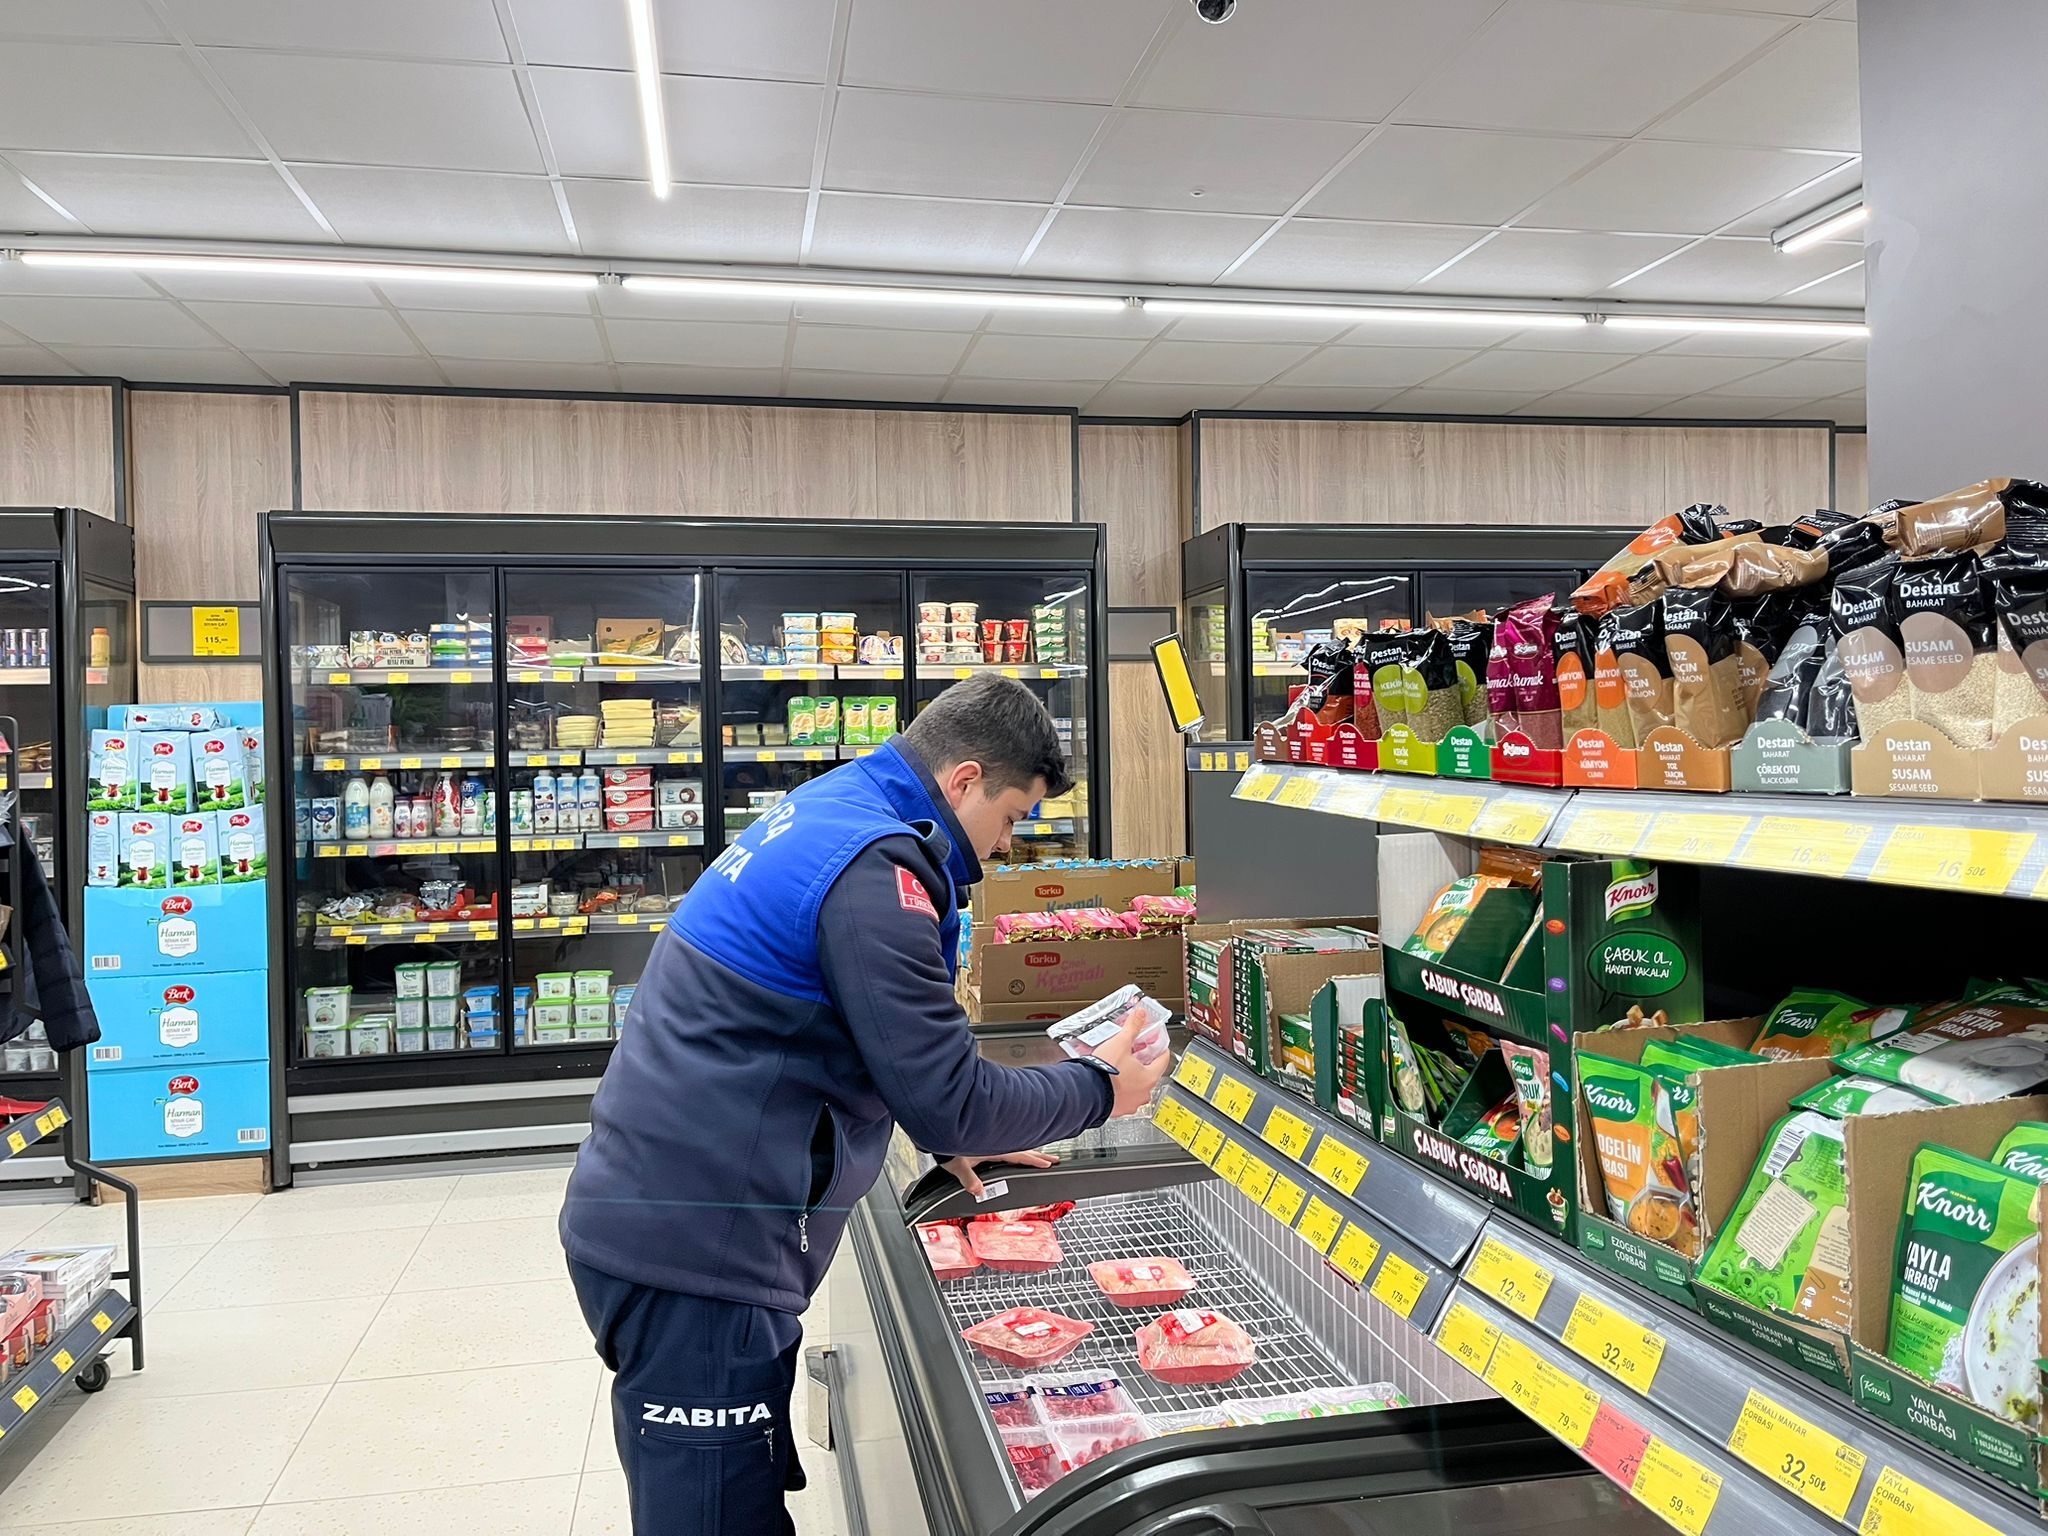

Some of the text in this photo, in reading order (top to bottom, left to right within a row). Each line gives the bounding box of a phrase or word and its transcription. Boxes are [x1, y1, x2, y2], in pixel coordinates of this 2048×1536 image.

[1900, 580, 1954, 597] Destan
[1841, 598, 1881, 616] Destan
[1906, 597, 1946, 608] BAHARAT
[1848, 611, 1877, 625] BAHARAT
[2006, 610, 2048, 626] Dest
[1555, 631, 1577, 643] Destan
[1906, 639, 1954, 653] SUSAM
[1370, 647, 1402, 661] Destan
[1844, 651, 1885, 665] SUSAM
[1513, 670, 1545, 688] Sumak
[1450, 736, 1473, 746] Destan
[1576, 738, 1605, 749] Destan
[1653, 741, 1684, 753] Destan
[1757, 737, 1795, 749] Destan
[1886, 737, 1932, 751] Destan
[2019, 736, 2048, 751] Des
[1762, 750, 1790, 758] BAHARAT
[1892, 753, 1926, 762] BAHARAT
[1892, 768, 1932, 781] SUSAM
[2026, 770, 2048, 783] SUS
[1037, 886, 1062, 897] Torku
[1607, 882, 1657, 908] Knorr
[1027, 953, 1058, 965] Torku
[1604, 946, 1673, 966] ÇABUK OL,
[1605, 964, 1633, 975] HAYATI
[167, 987, 191, 1002] Berk
[1421, 968, 1505, 1017] ÇABUK ÇORBA
[162, 1017, 197, 1028] Harman
[1776, 1008, 1818, 1030] Knorr
[172, 1078, 196, 1092] Berk
[1584, 1083, 1636, 1115] Knorr
[166, 1107, 202, 1118] Harman
[1413, 1129, 1459, 1169] ÇABUK
[1459, 1153, 1514, 1199] ÇORBA
[2002, 1150, 2048, 1182] Kno
[1916, 1181, 1992, 1232] Knorr
[1611, 1236, 1647, 1260] EZOGELİN
[1614, 1249, 1647, 1271] ÇORBASI
[1863, 1379, 1892, 1401] Knorr
[642, 1402, 772, 1427] ZABITA
[1910, 1394, 1948, 1422] YAYLA
[1743, 1407, 1774, 1431] ÇORBASI
[1747, 1397, 1807, 1437] KREMALI MANTAR
[1906, 1407, 1957, 1441] ÇORBASI
[1780, 1452, 1827, 1492] 32,50₺
[1882, 1474, 1910, 1496] YAYLA
[1876, 1486, 1915, 1514] ÇORBASI
